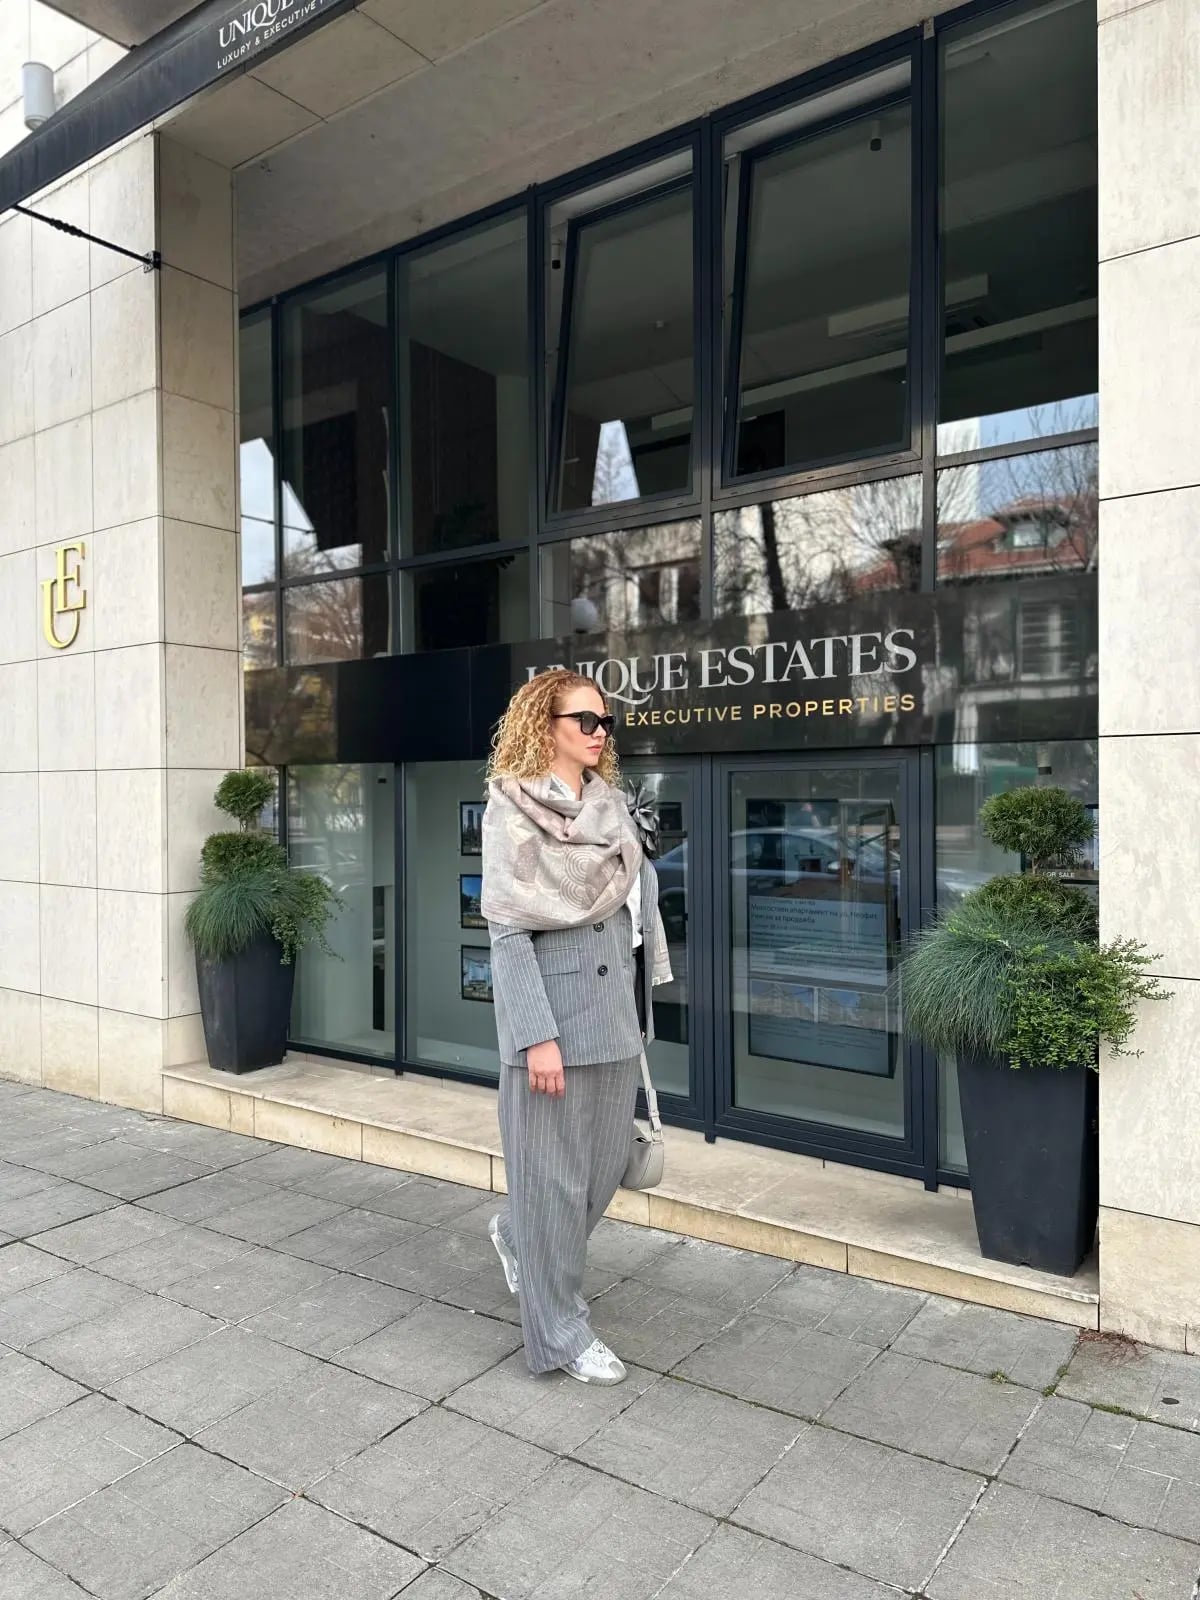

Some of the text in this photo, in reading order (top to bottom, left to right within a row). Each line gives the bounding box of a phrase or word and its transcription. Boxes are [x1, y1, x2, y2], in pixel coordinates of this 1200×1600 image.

[217, 0, 317, 70] LUXURY & EXECUTIVE
[698, 628, 918, 689] ESTATES
[625, 693, 917, 727] EXECUTIVE PROPERTIES
